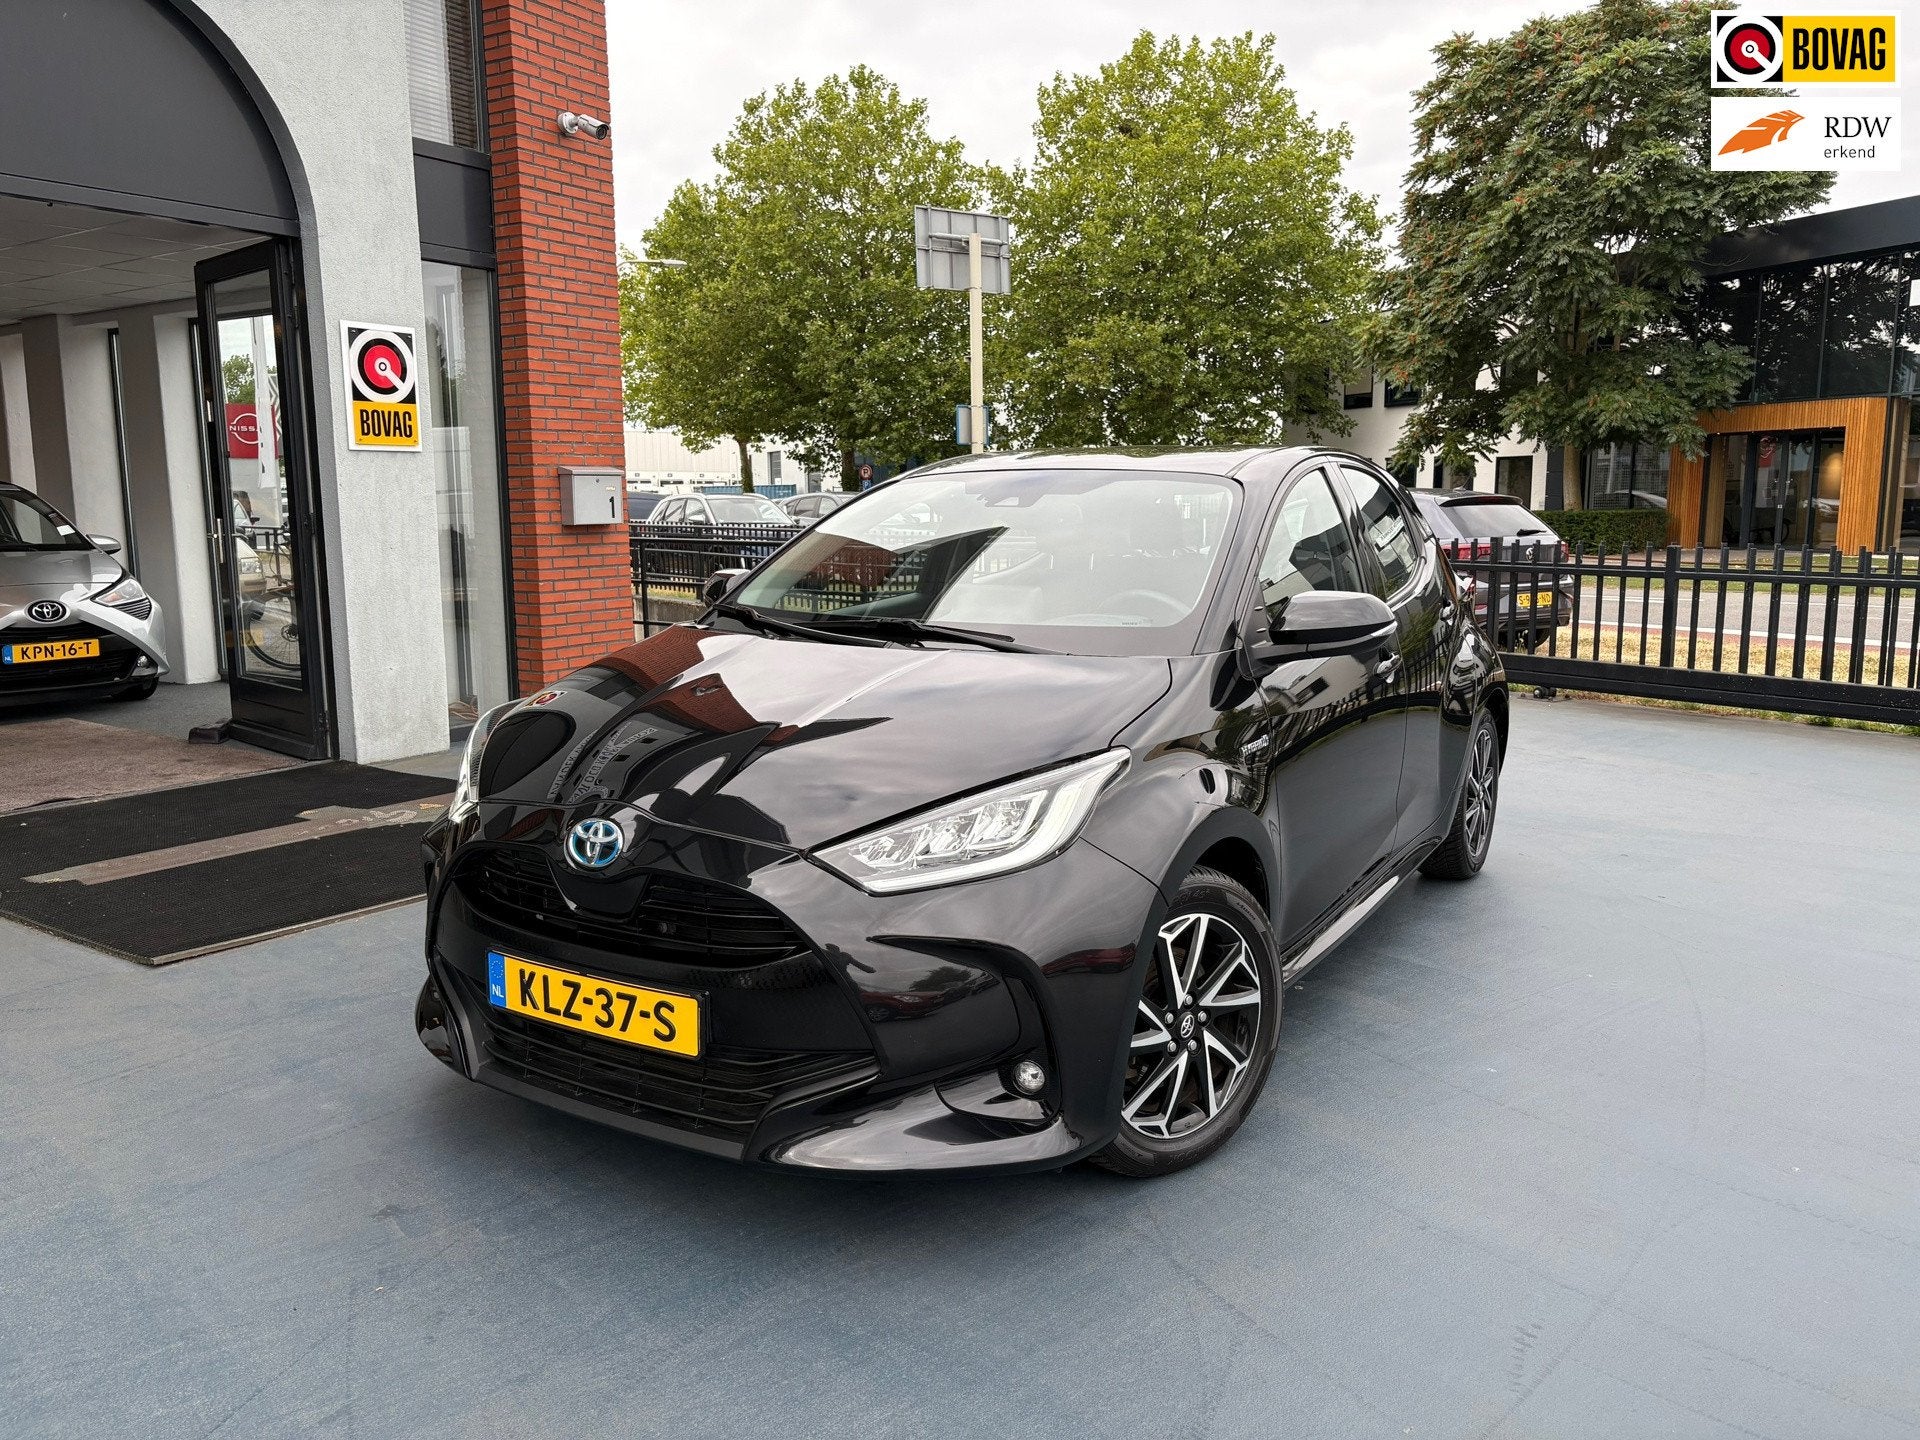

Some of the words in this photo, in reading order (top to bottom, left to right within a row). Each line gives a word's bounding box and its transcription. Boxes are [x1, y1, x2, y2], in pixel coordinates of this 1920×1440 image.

[359, 408, 413, 438] BOVAG
[609, 496, 615, 518] 1
[21, 642, 92, 660] KPN-16-T
[492, 984, 505, 998] NL
[519, 968, 677, 1042] KLZ-37-S
